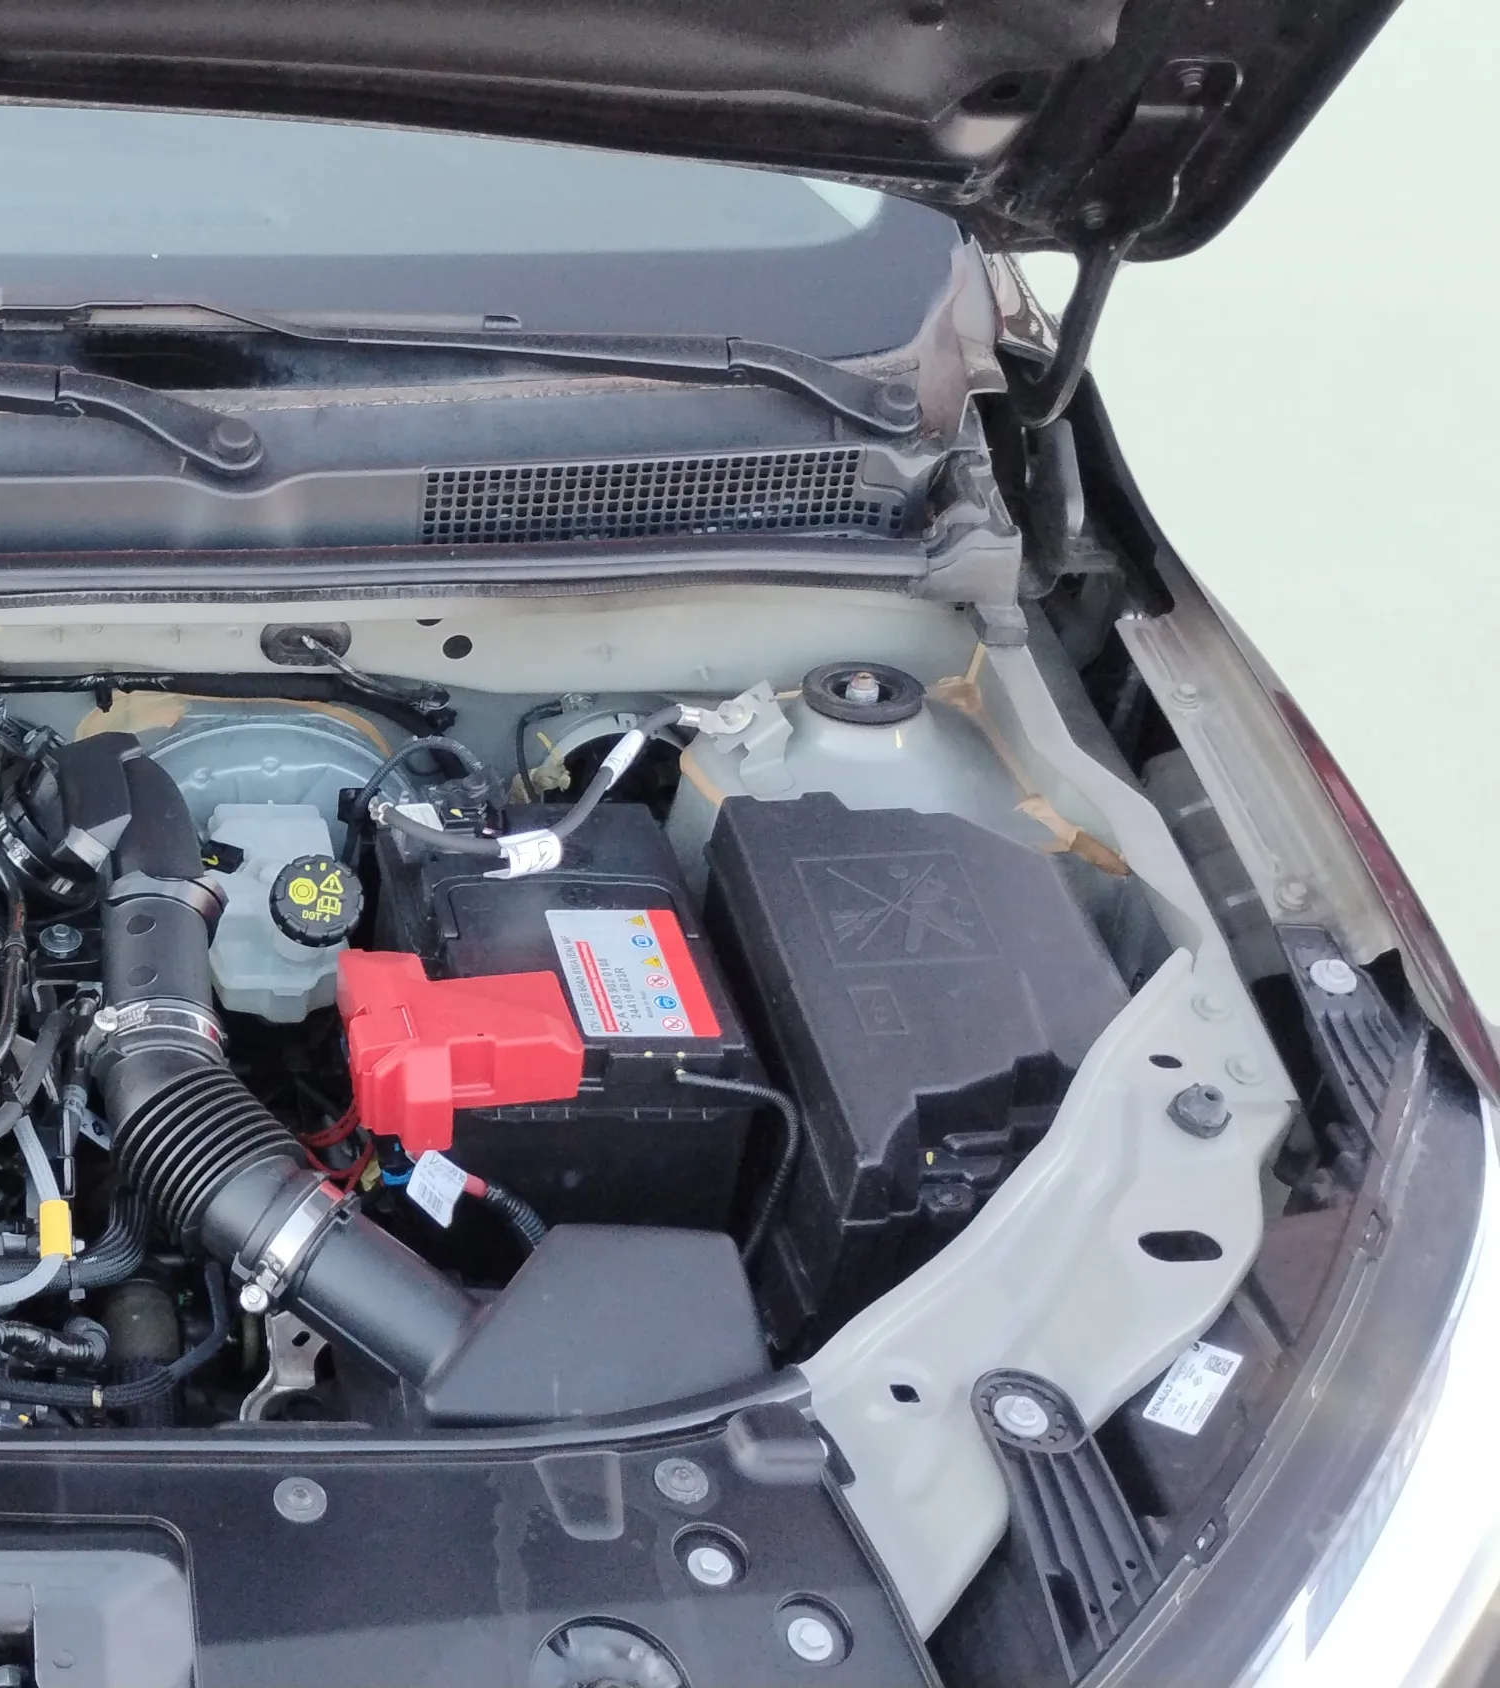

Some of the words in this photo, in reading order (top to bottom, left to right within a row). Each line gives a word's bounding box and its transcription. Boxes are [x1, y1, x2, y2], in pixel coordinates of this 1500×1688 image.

[301, 909, 322, 921] DOT
[323, 913, 331, 923] 4
[618, 1019, 633, 1033] DC
[1147, 1383, 1173, 1417] RENAULT
